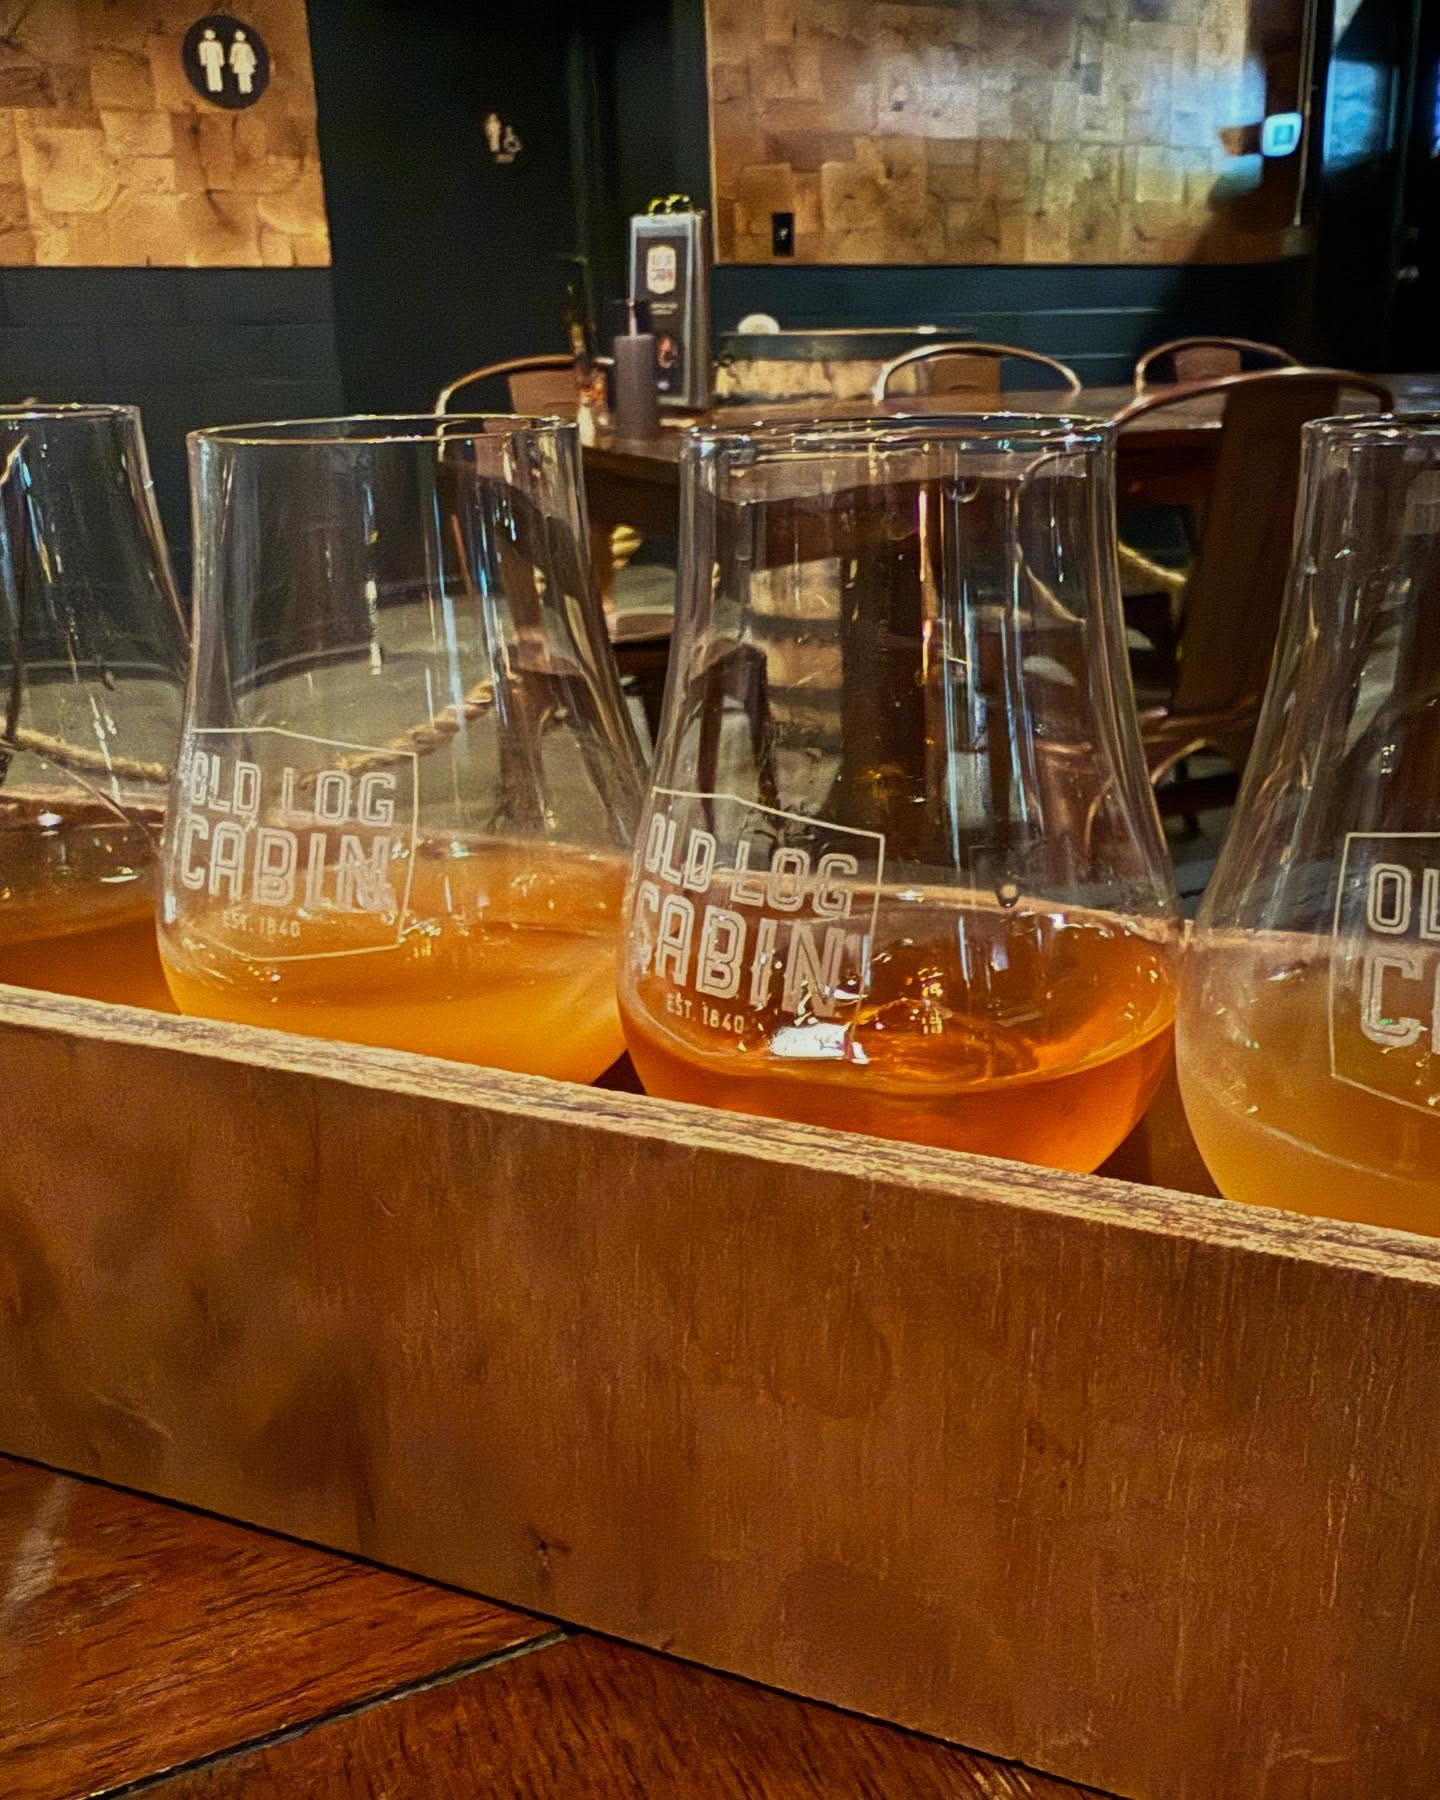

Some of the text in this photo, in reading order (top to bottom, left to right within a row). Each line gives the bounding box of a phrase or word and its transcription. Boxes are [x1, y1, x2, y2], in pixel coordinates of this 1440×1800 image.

[190, 750, 397, 827] OLD LOG
[180, 812, 398, 914] CABIN
[645, 812, 858, 920] OLD LOG
[631, 880, 847, 1018] CABIN
[702, 1001, 745, 1035] 1840
